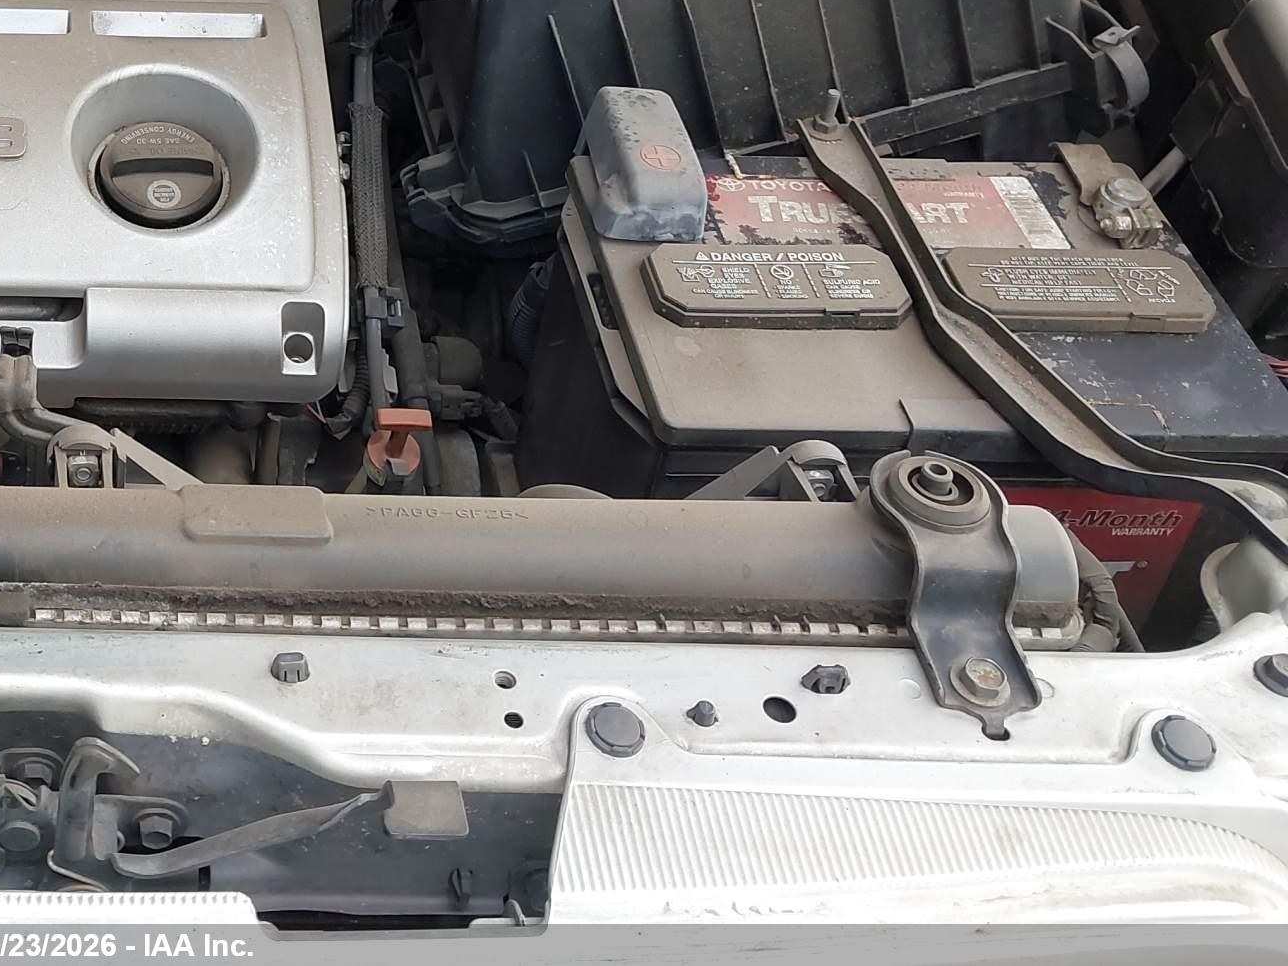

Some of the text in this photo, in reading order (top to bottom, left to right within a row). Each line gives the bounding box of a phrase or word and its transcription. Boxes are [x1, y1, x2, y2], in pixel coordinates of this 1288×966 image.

[120, 126, 165, 145] CONSERVING
[747, 179, 833, 193] TOYOTA
[710, 252, 773, 262] DANGER
[786, 252, 845, 262] POISON
[1111, 527, 1175, 537] WARRANTY
